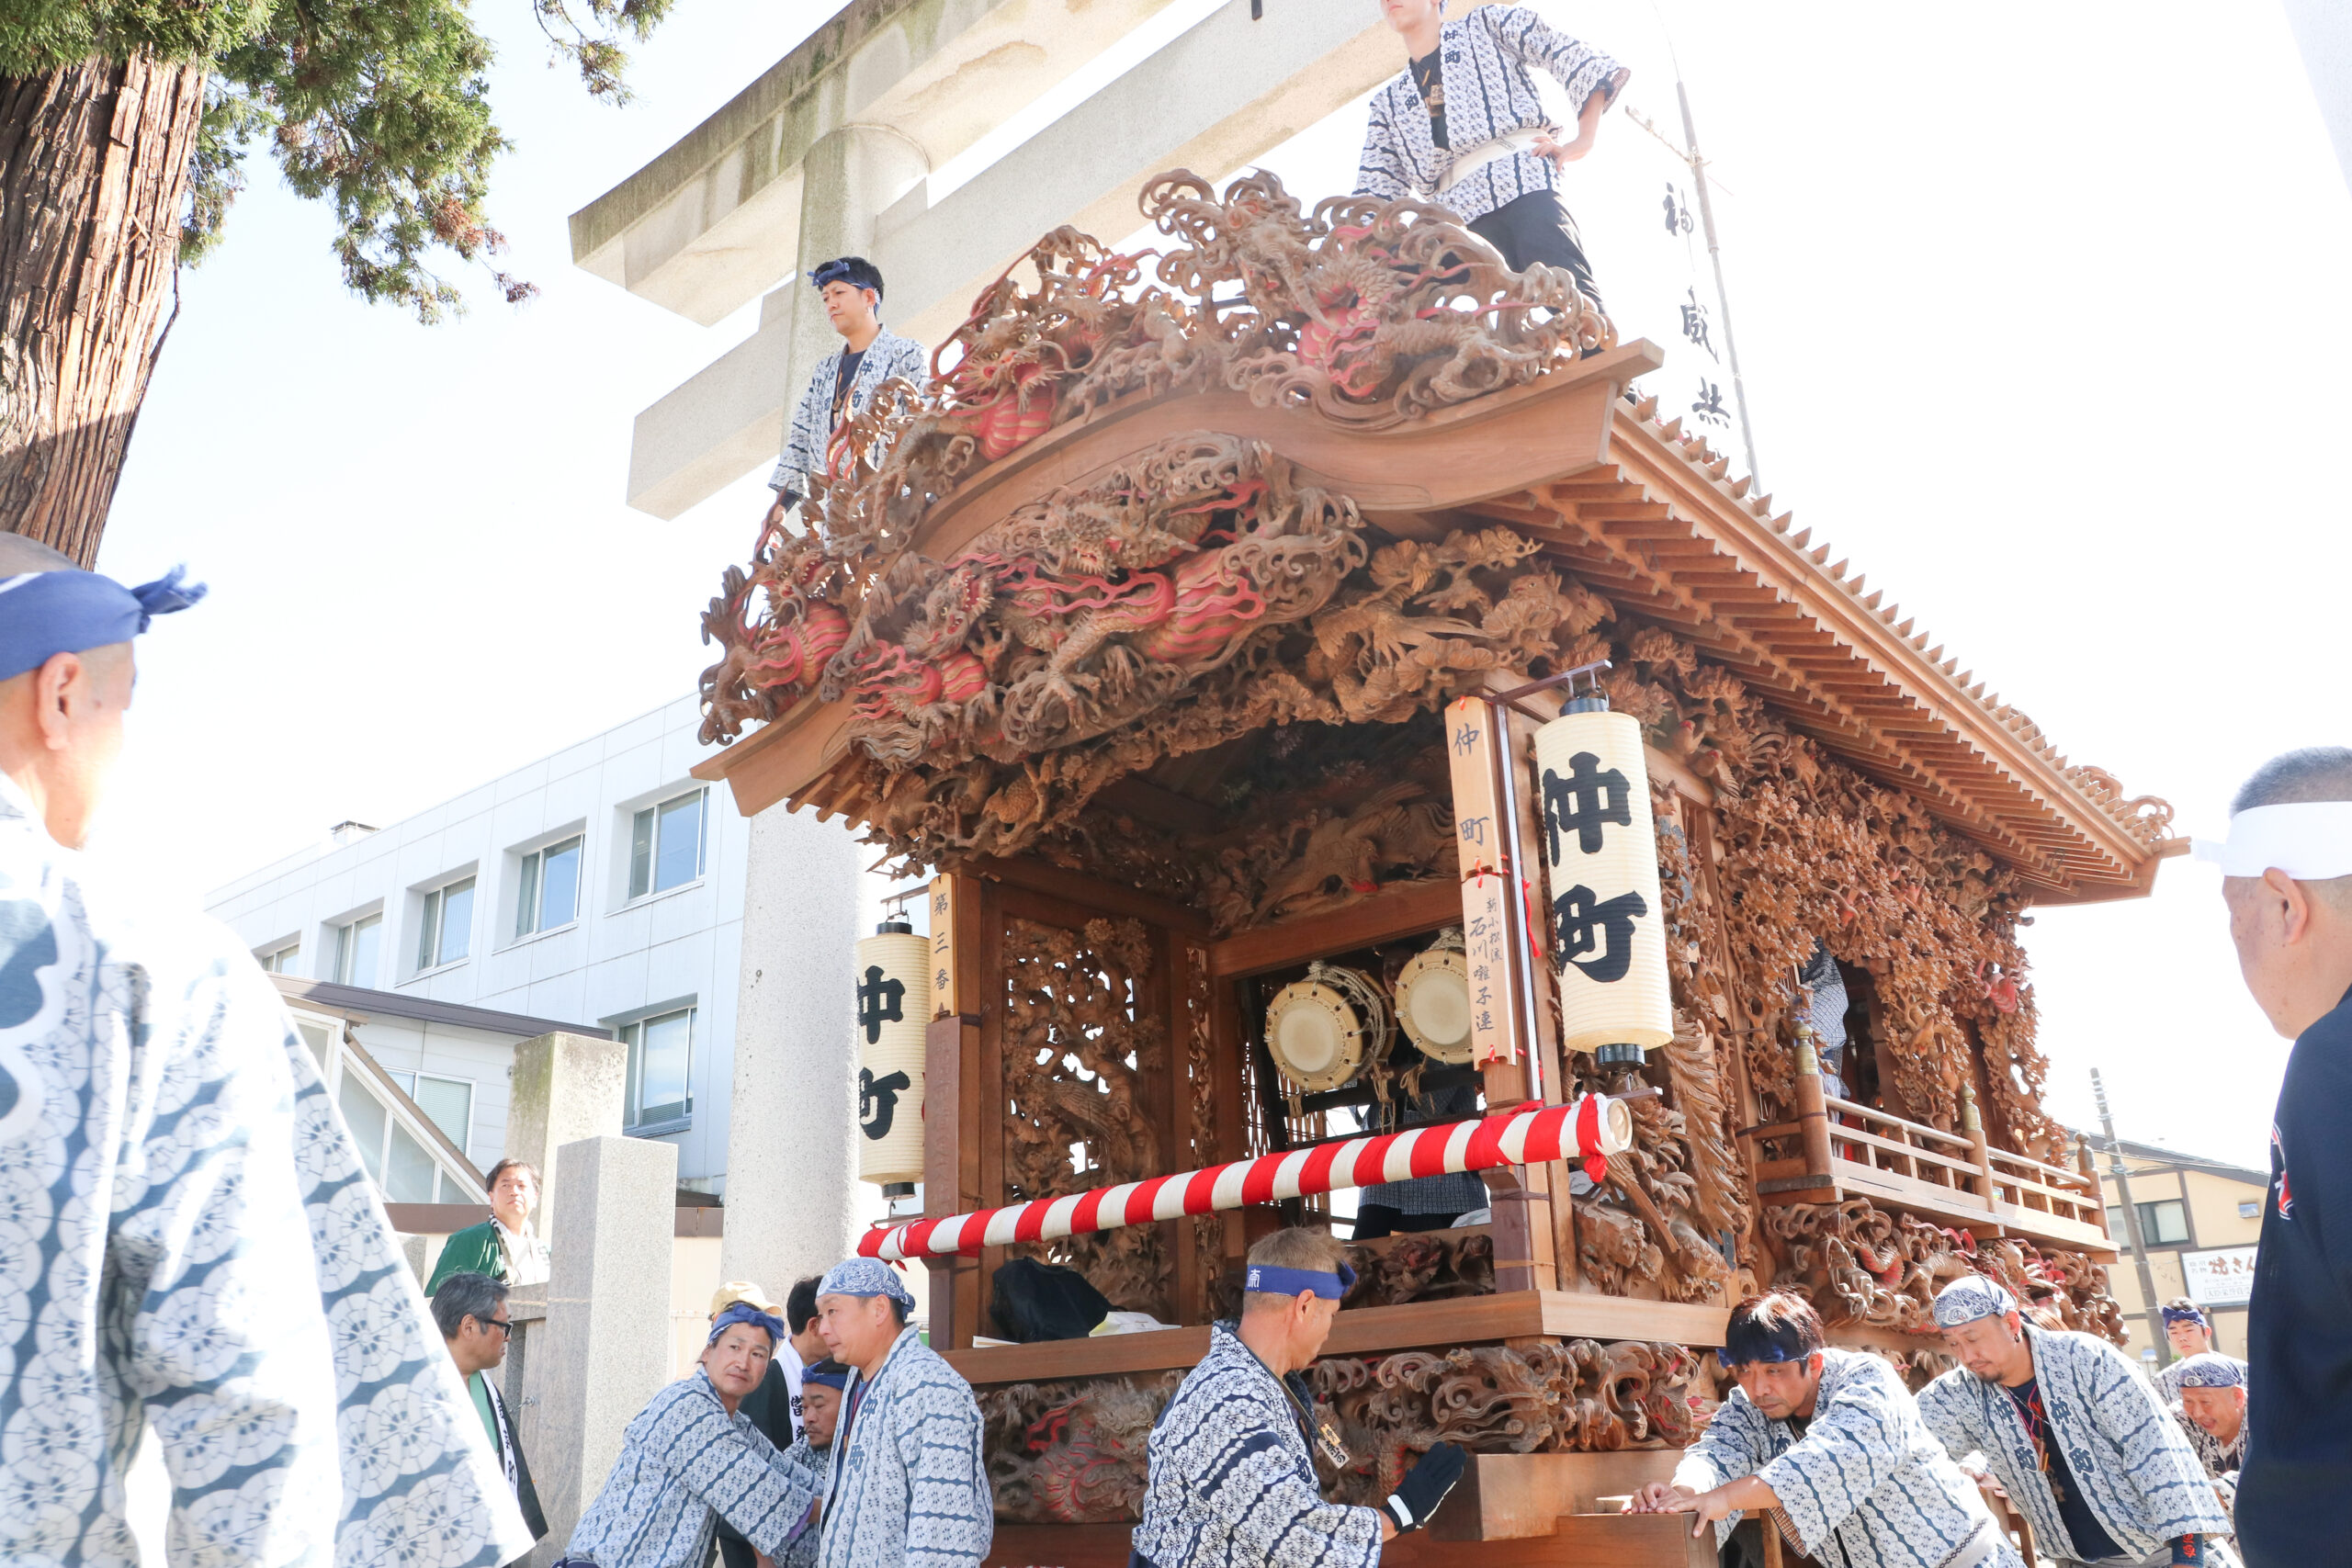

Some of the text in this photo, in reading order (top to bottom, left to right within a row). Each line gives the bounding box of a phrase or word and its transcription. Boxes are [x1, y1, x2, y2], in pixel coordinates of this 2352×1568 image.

[1453, 722, 1490, 846] 仲町
[933, 892, 950, 990] 第三番
[1543, 751, 1648, 982] 仲町
[856, 965, 910, 1140] 仲町
